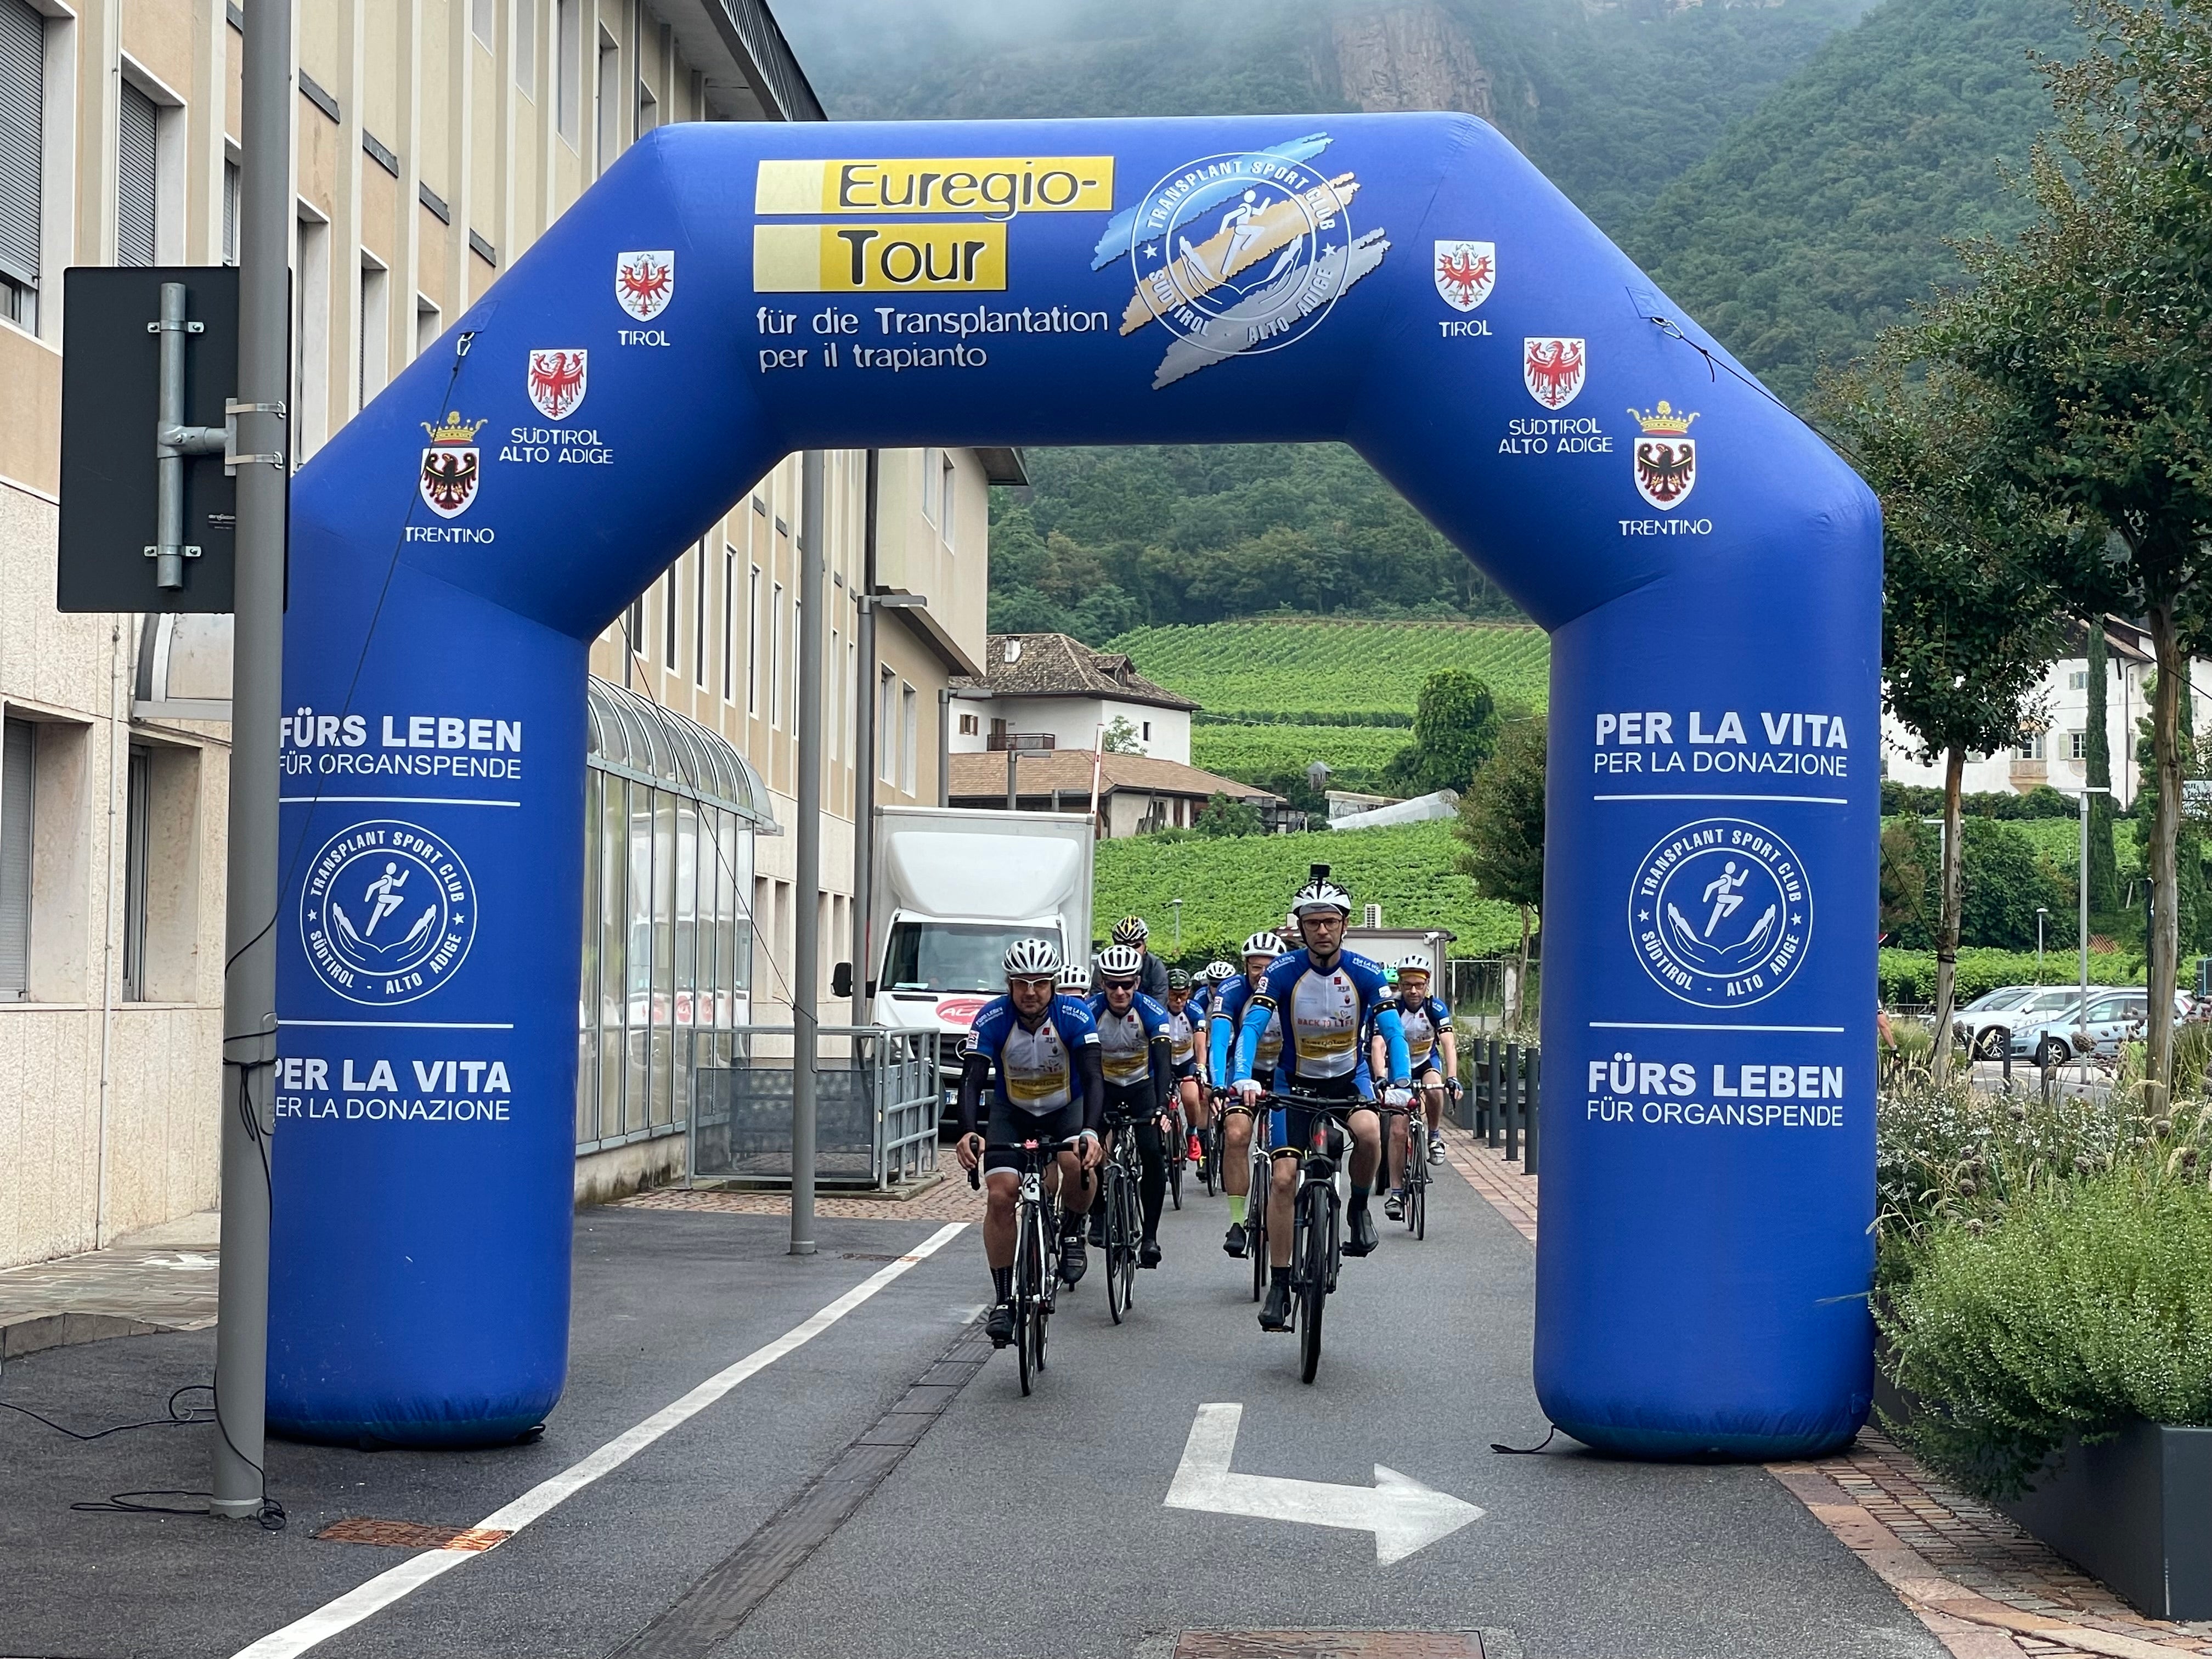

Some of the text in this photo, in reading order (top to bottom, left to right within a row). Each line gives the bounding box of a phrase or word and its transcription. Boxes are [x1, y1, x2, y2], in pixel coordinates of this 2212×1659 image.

[839, 161, 1098, 221] Euregio-
[1147, 161, 1335, 230] TRANSPLANT SPORT CLUB
[837, 230, 986, 286] Tour
[1148, 269, 1208, 336] SÜDTIROL
[1247, 316, 1290, 342] ALTO
[1296, 266, 1334, 317] ADIGE
[618, 330, 670, 347] TIROL
[756, 305, 1109, 339] für die Transplantation
[1439, 320, 1492, 337] TIROL
[759, 341, 988, 373] per il trapianto
[511, 427, 603, 445] SÜDTIROL
[1509, 417, 1601, 435] SÜDTIROL
[499, 447, 614, 464] ALTO ADIGE
[1498, 437, 1613, 454] ALTO ADIGE
[404, 526, 494, 544] TRENTINO
[1618, 518, 1712, 536] TRENTINO
[280, 707, 521, 752] FÜRS LEBEN
[1595, 712, 1848, 749] PER LA VITA
[319, 754, 521, 778] ORGANSPENDE
[1594, 751, 1847, 777] PER LA DONAZIONE
[311, 831, 464, 902] TRANSPLANT SPORT CLUB
[1641, 828, 1802, 902] TRANSPLANT SPORT CLUB
[310, 930, 354, 988] SÜDTIROL
[386, 972, 423, 994] ALTO
[430, 933, 461, 974] ADIGE
[1641, 931, 1694, 991] SÜDTIROL
[1727, 974, 1764, 997] ALTO
[1770, 933, 1799, 975] ADIGE
[343, 1059, 398, 1092] LA
[412, 1060, 511, 1093] VITA
[1589, 1052, 1843, 1098] FÜRS LEBEN
[276, 1097, 510, 1121] ER LA DONAZIONE
[1587, 1096, 1843, 1127] FÜR ORGANSPENDE
